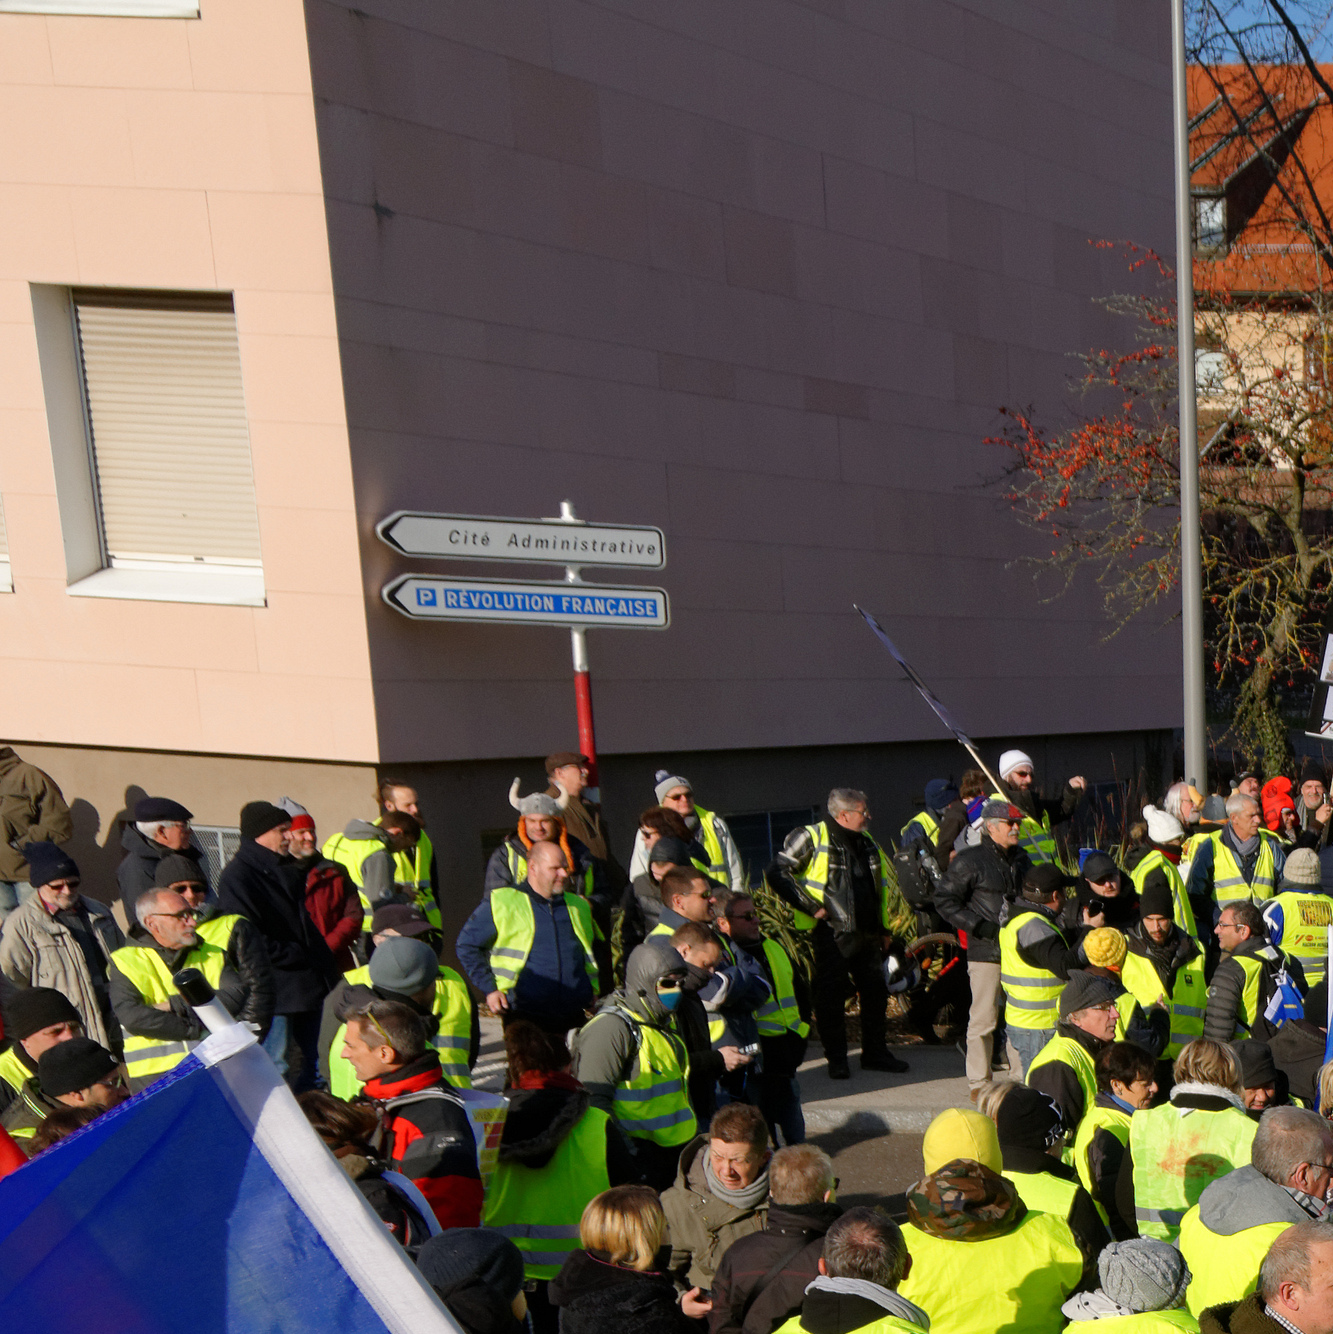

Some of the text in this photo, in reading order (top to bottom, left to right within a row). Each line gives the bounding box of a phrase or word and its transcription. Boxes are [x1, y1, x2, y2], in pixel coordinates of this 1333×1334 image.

[448, 529, 657, 556] Cité Administrative
[419, 588, 656, 618] P RÉVOLUTION FRANÇAISE
